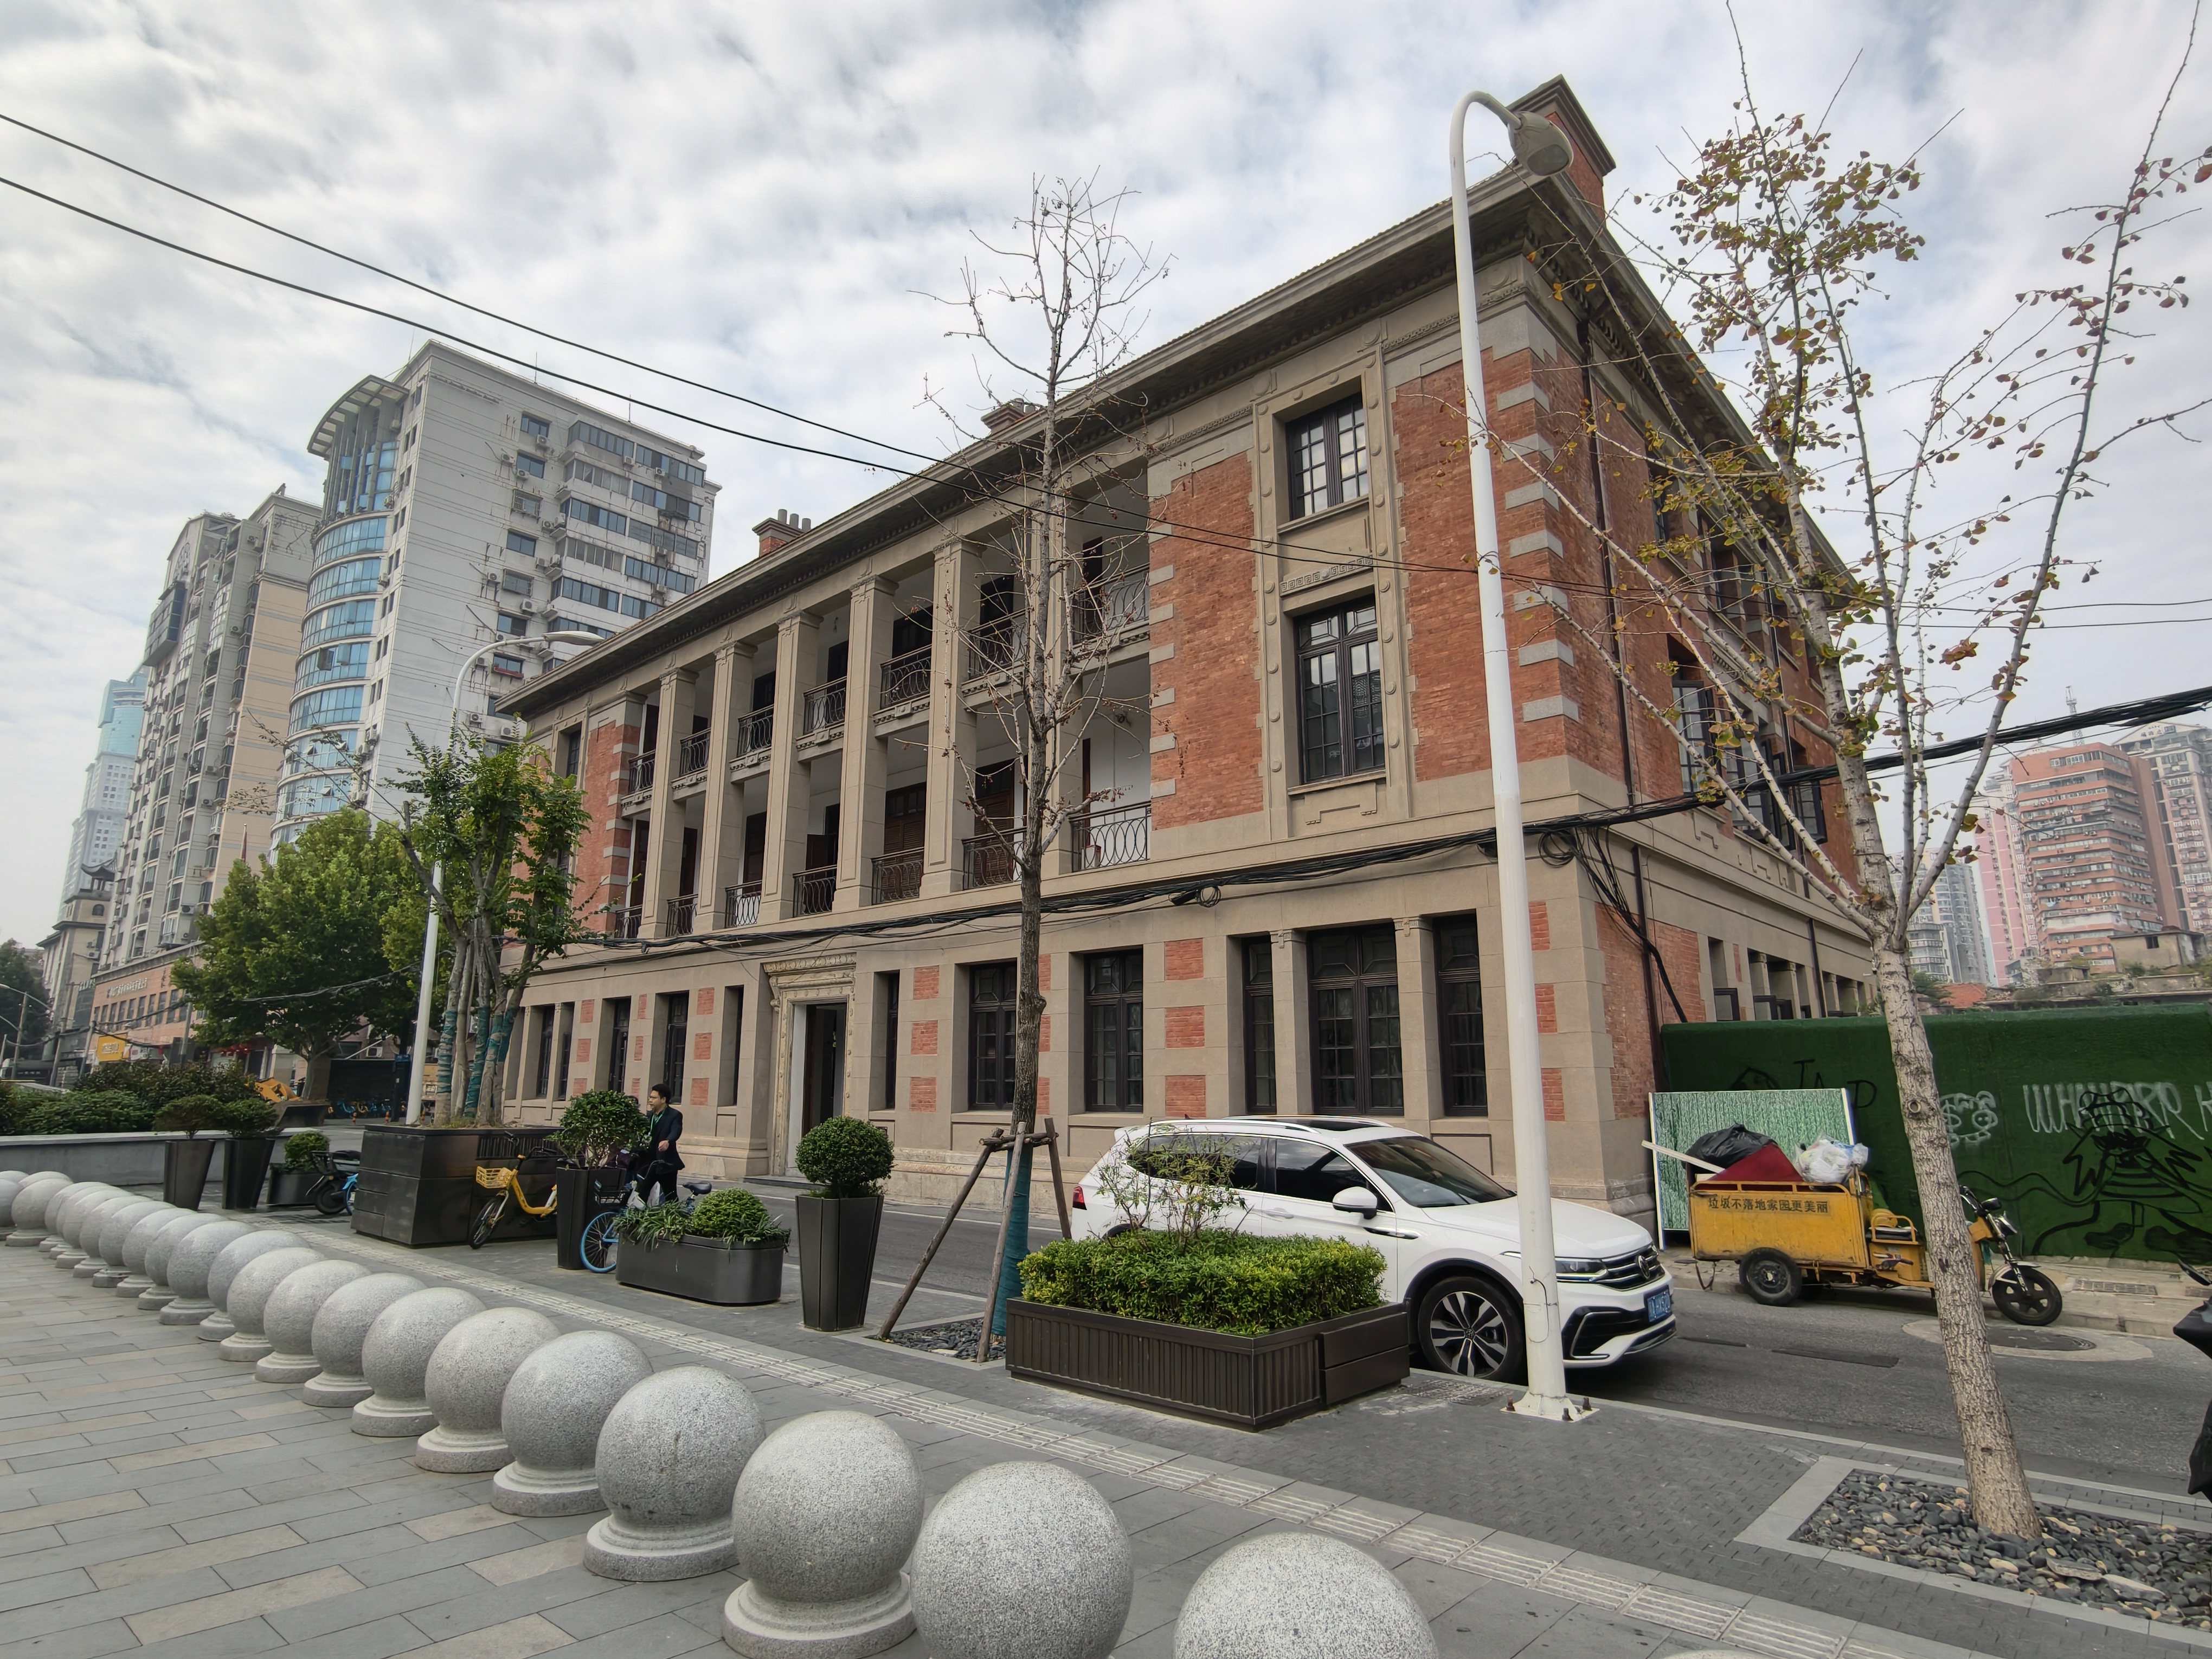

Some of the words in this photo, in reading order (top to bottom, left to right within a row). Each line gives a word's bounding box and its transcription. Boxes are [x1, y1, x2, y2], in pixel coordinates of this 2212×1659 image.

[1708, 1195, 1828, 1213] 垃圾不落地家园更美丽
